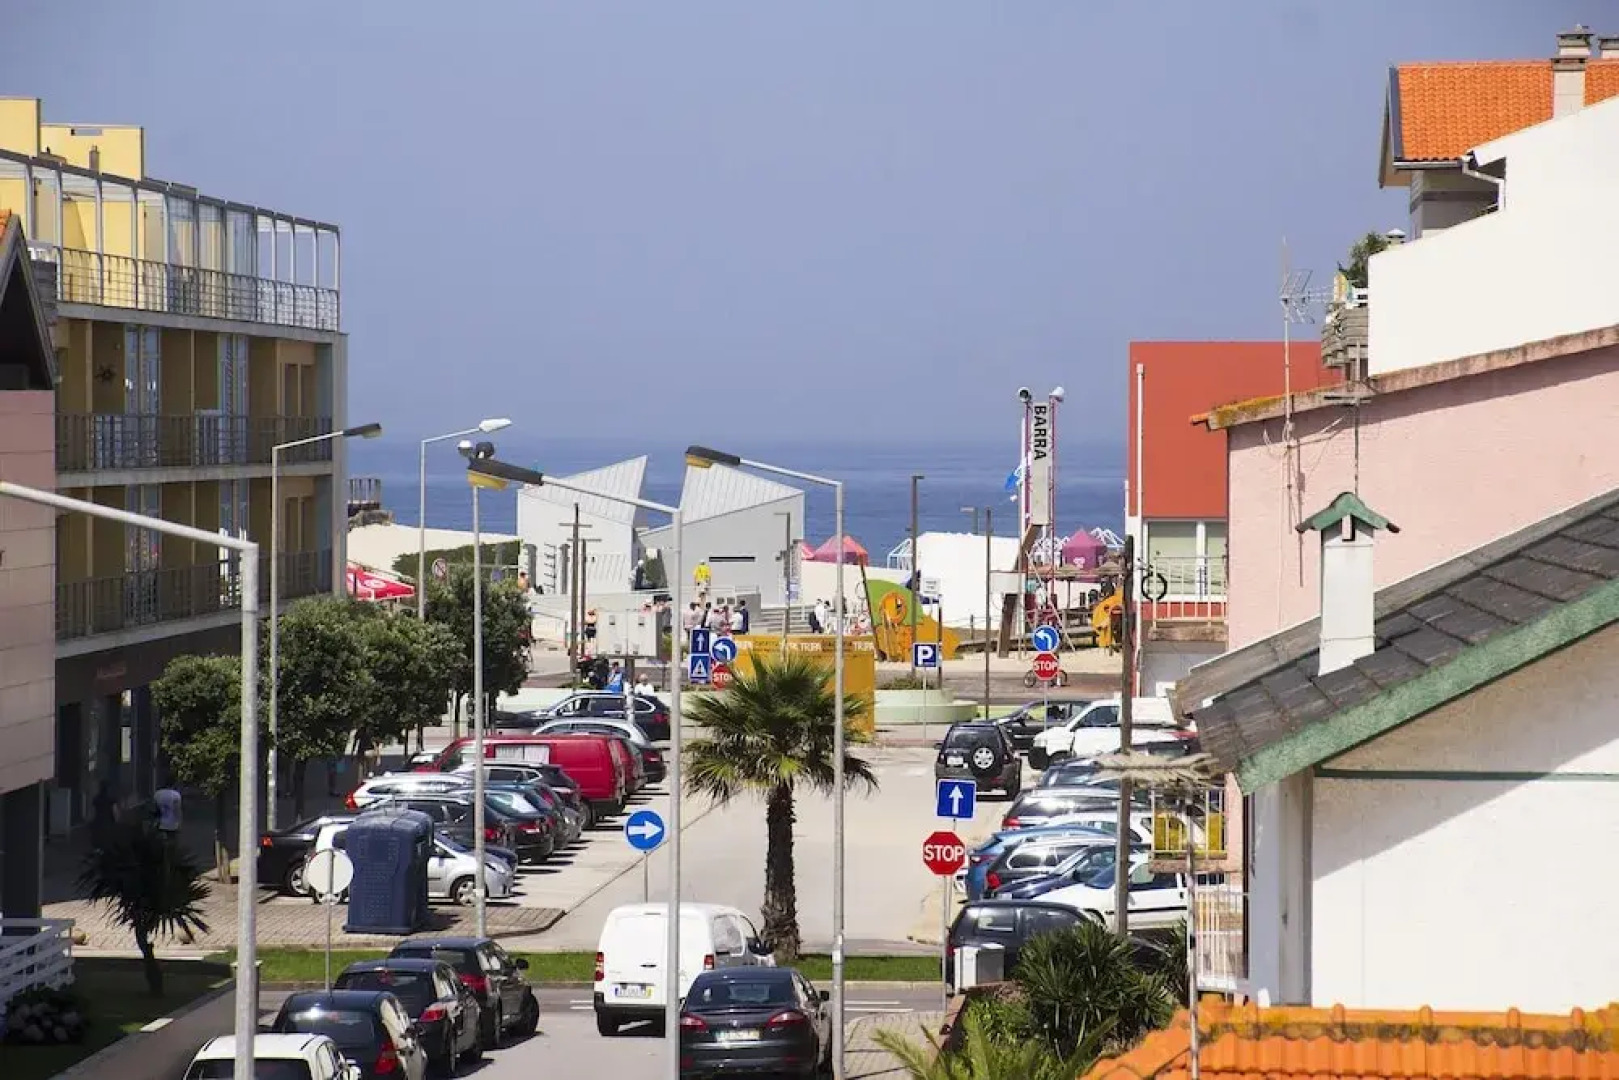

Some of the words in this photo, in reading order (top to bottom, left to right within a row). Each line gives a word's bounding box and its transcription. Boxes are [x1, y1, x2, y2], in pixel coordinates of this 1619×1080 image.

[1034, 405, 1047, 461] BARRA
[917, 645, 933, 665] P
[1033, 660, 1058, 671] STOP
[713, 673, 733, 682] STO
[924, 844, 964, 862] STOP
